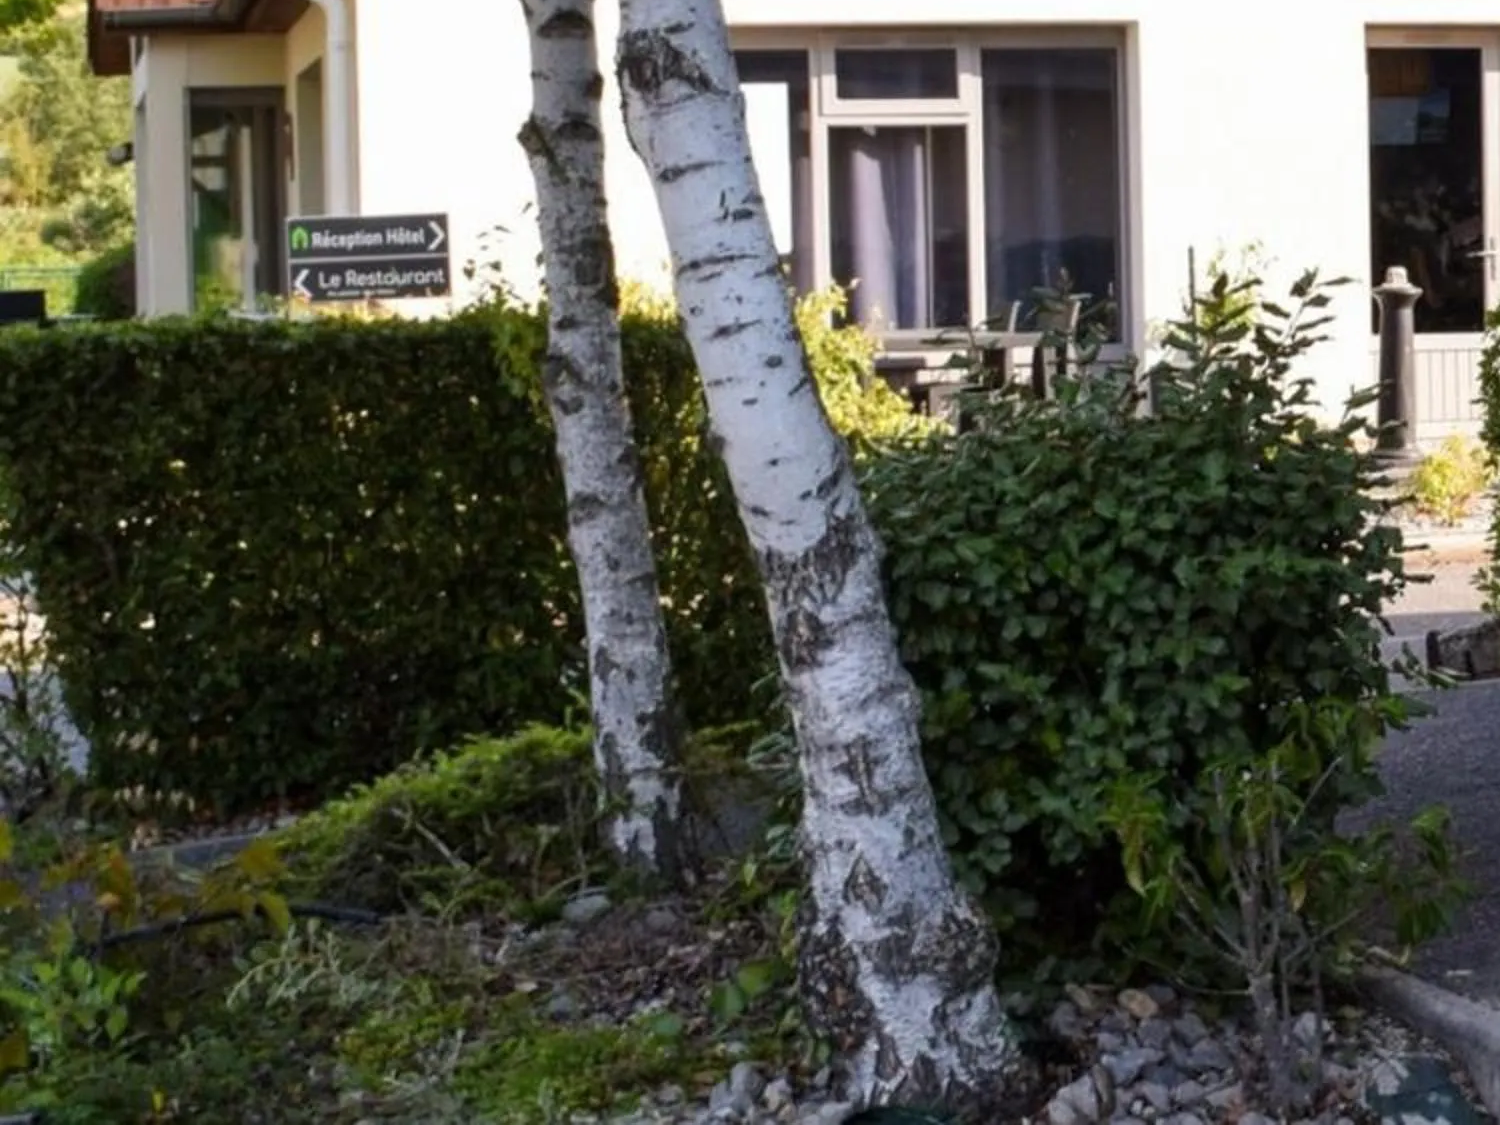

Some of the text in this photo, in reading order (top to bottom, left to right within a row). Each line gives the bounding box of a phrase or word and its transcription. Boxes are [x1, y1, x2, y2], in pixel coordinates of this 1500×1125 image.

[312, 226, 424, 250] Réception Hôtel
[318, 267, 446, 290] Le Restaurant
